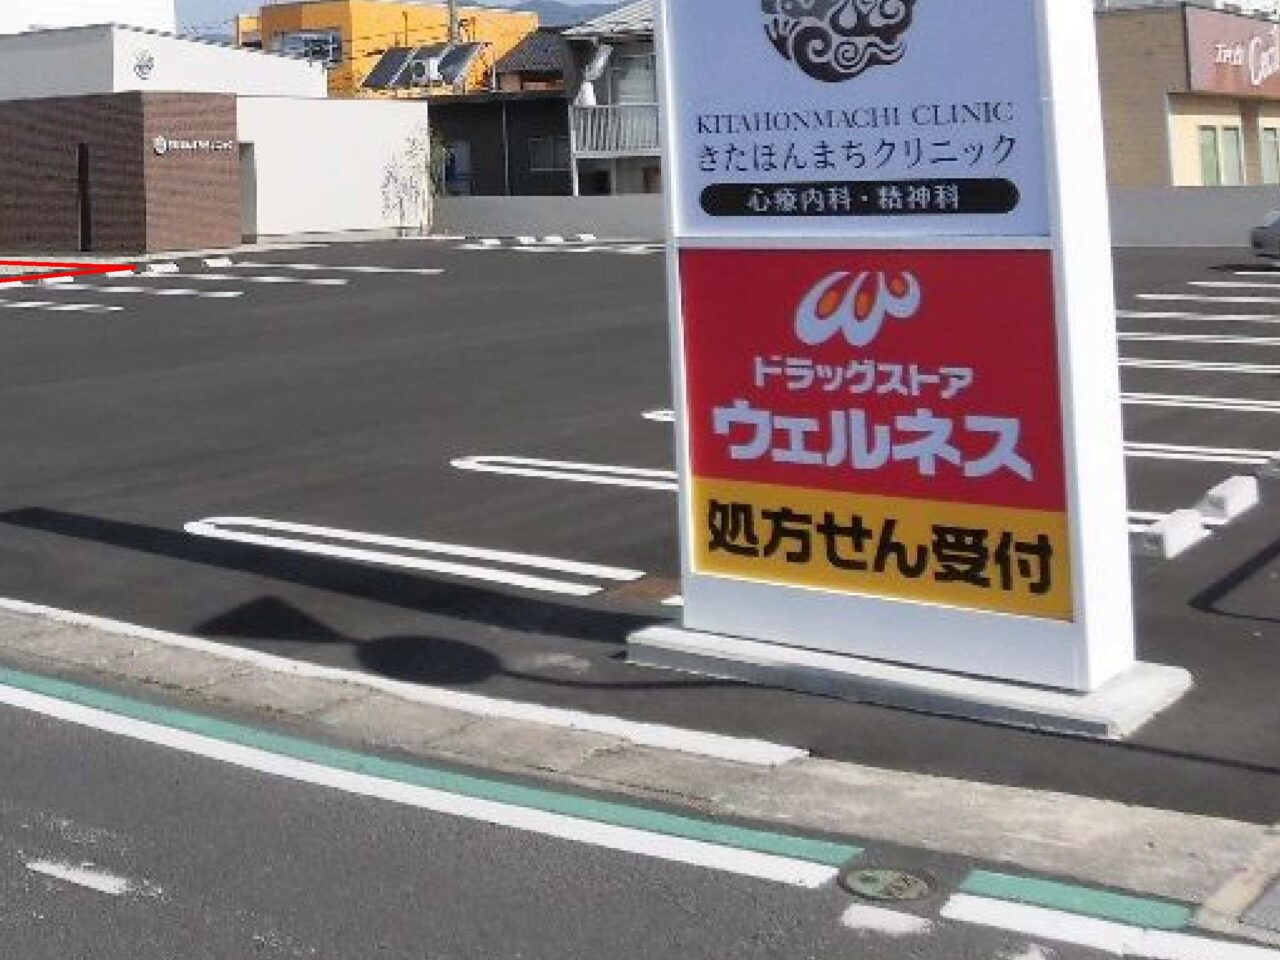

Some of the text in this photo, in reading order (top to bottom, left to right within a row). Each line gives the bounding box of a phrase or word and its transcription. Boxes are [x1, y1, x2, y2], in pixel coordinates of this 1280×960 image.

[697, 101, 1013, 134] KITAHONMACHI CLINIC
[697, 134, 1016, 172] きたほんまちクリニック
[754, 355, 974, 399] ドラッグストア
[711, 399, 1034, 481] ウェルネス
[707, 499, 1054, 594] 処方せん受付
